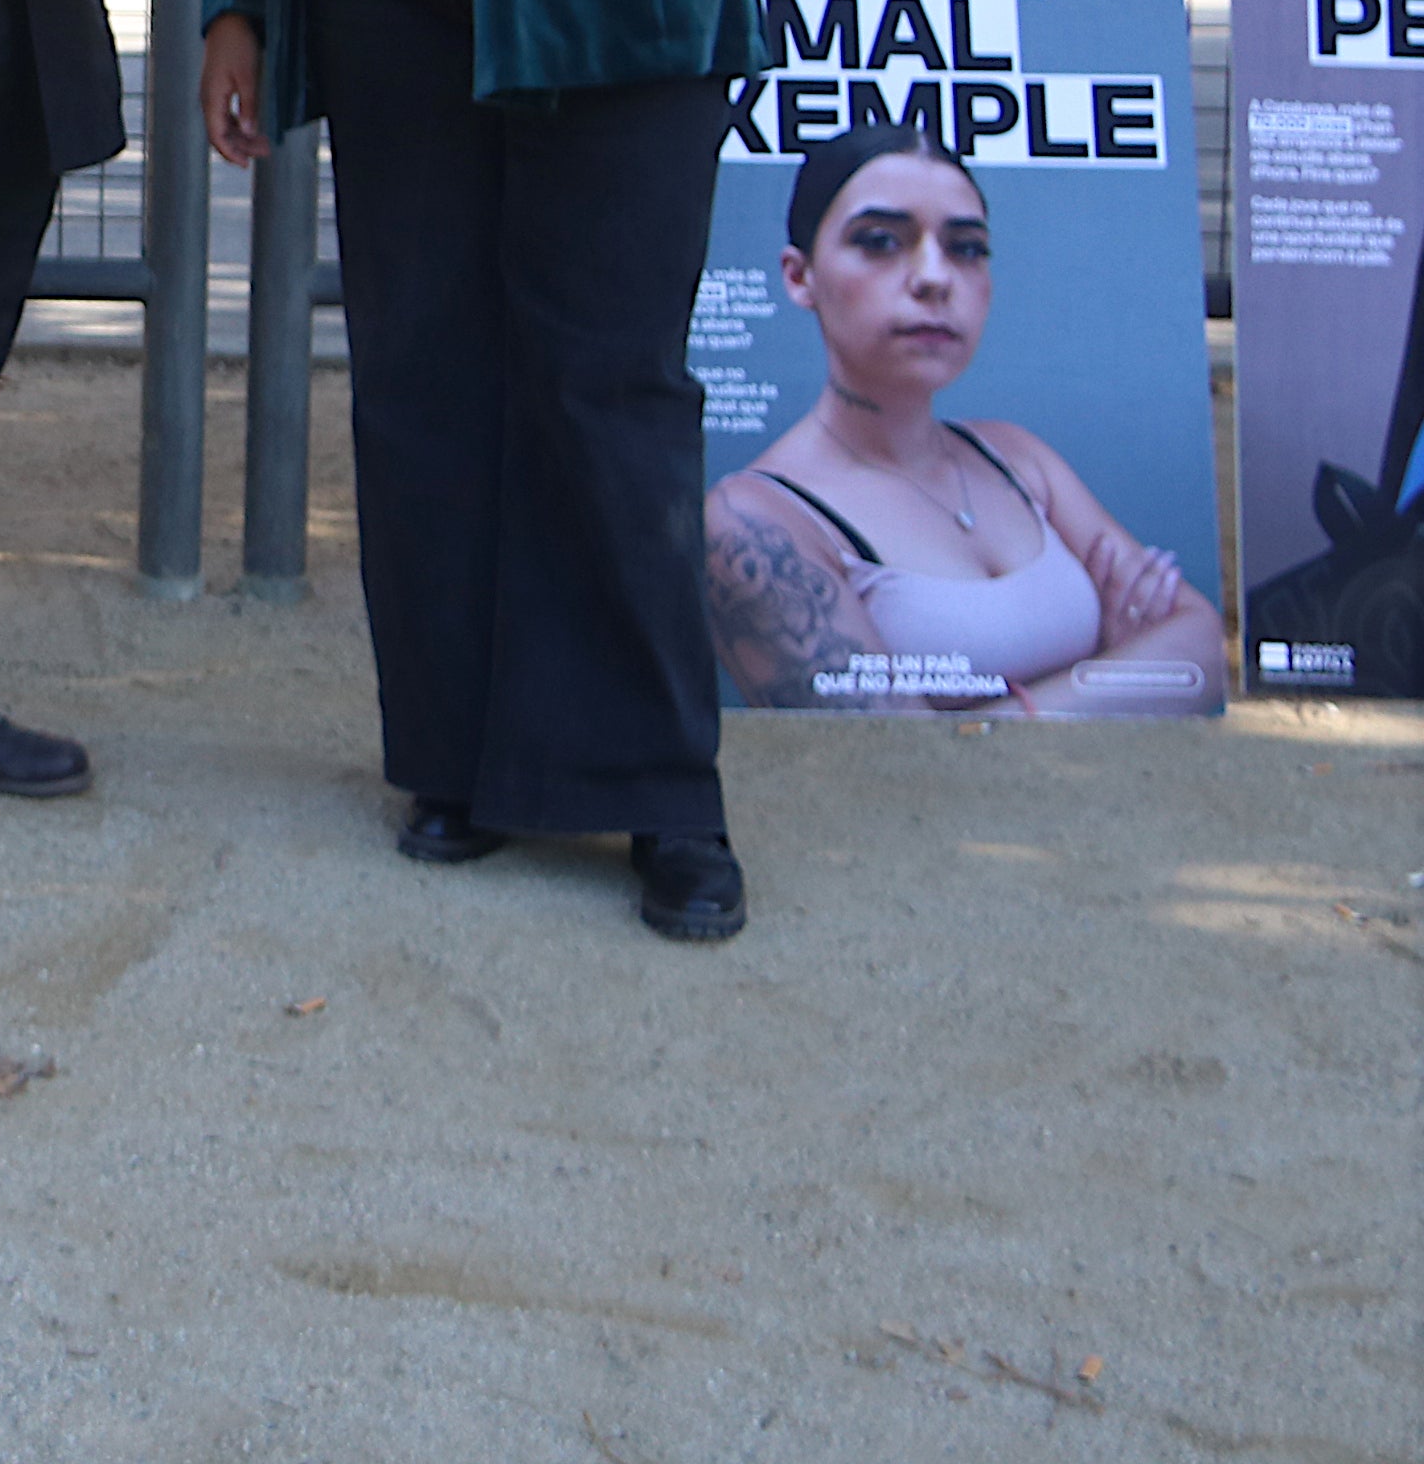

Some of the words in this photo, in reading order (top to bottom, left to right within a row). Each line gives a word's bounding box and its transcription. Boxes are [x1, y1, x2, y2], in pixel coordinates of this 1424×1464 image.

[849, 652, 891, 674] PER
[891, 654, 923, 674] UN
[924, 650, 973, 674] PAÍS
[812, 671, 857, 697] QUE
[857, 673, 891, 695] NO
[891, 673, 1010, 698] ABANDONA
